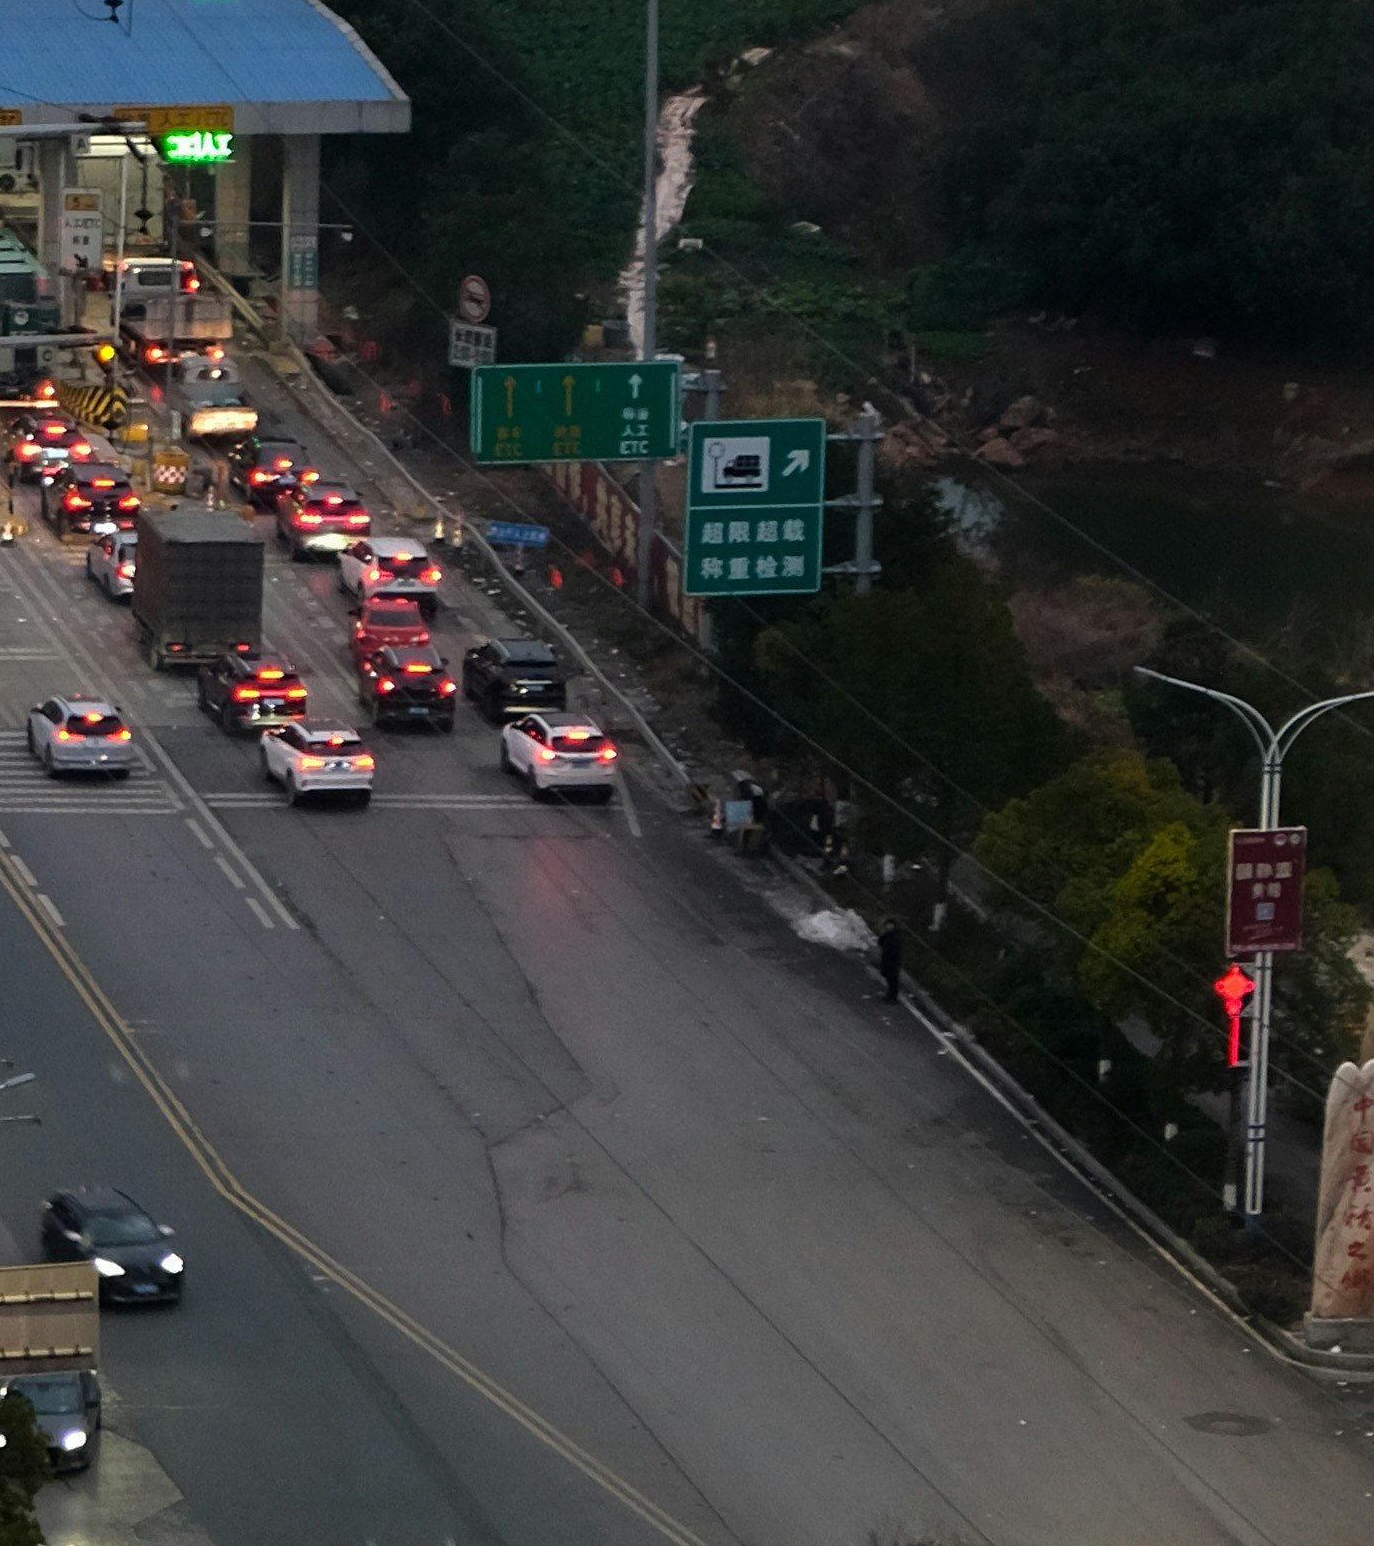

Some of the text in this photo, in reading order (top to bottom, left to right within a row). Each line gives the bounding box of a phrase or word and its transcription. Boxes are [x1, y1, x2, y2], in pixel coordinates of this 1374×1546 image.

[623, 424, 649, 437] 人工
[619, 440, 650, 455] ETC
[702, 519, 806, 545] 超限超载
[701, 555, 805, 580] 称重检测
